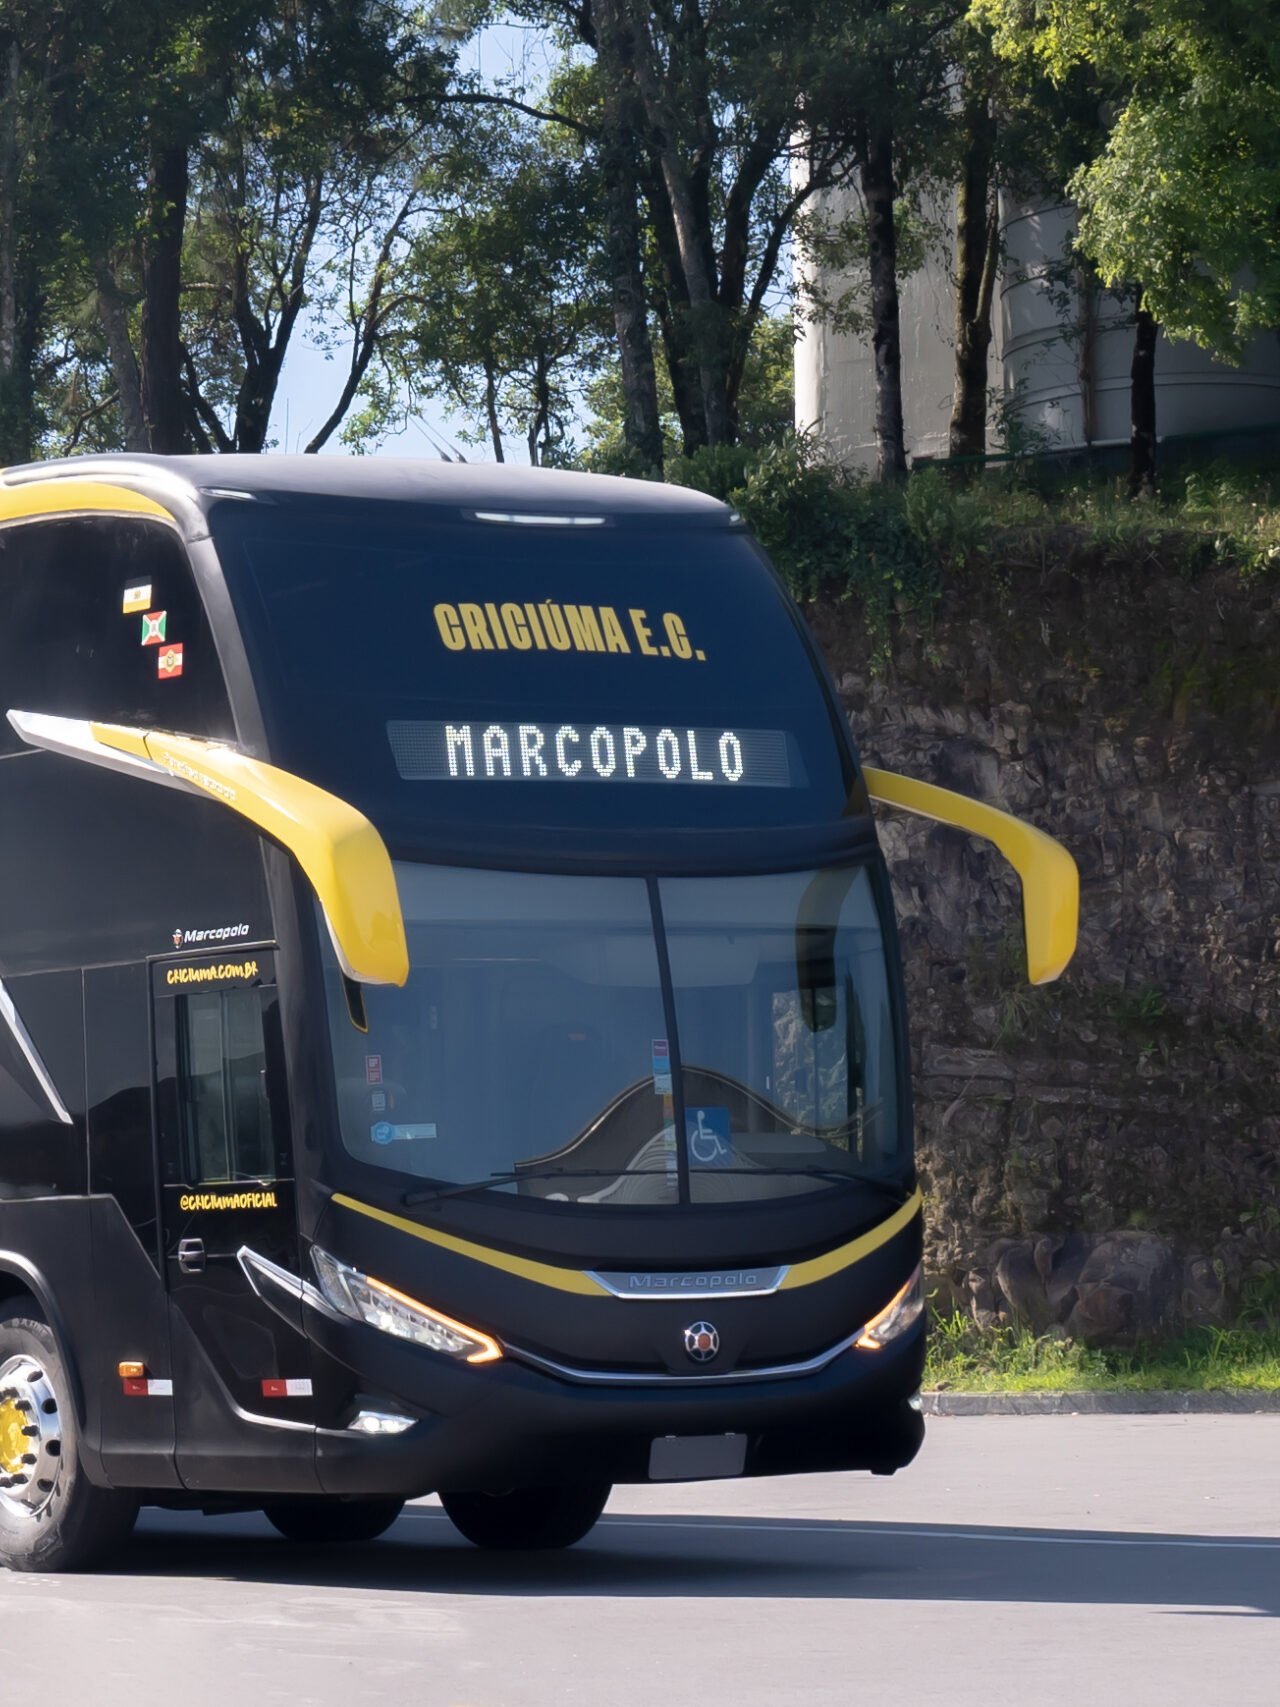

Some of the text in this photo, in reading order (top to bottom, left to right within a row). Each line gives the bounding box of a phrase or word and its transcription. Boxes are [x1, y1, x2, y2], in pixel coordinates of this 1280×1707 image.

[433, 599, 707, 661] CRICIÚMA E.C.
[445, 725, 744, 782] MARCOPOLO
[184, 923, 250, 944] Marcopolo
[628, 1272, 758, 1289] Marcopolo
